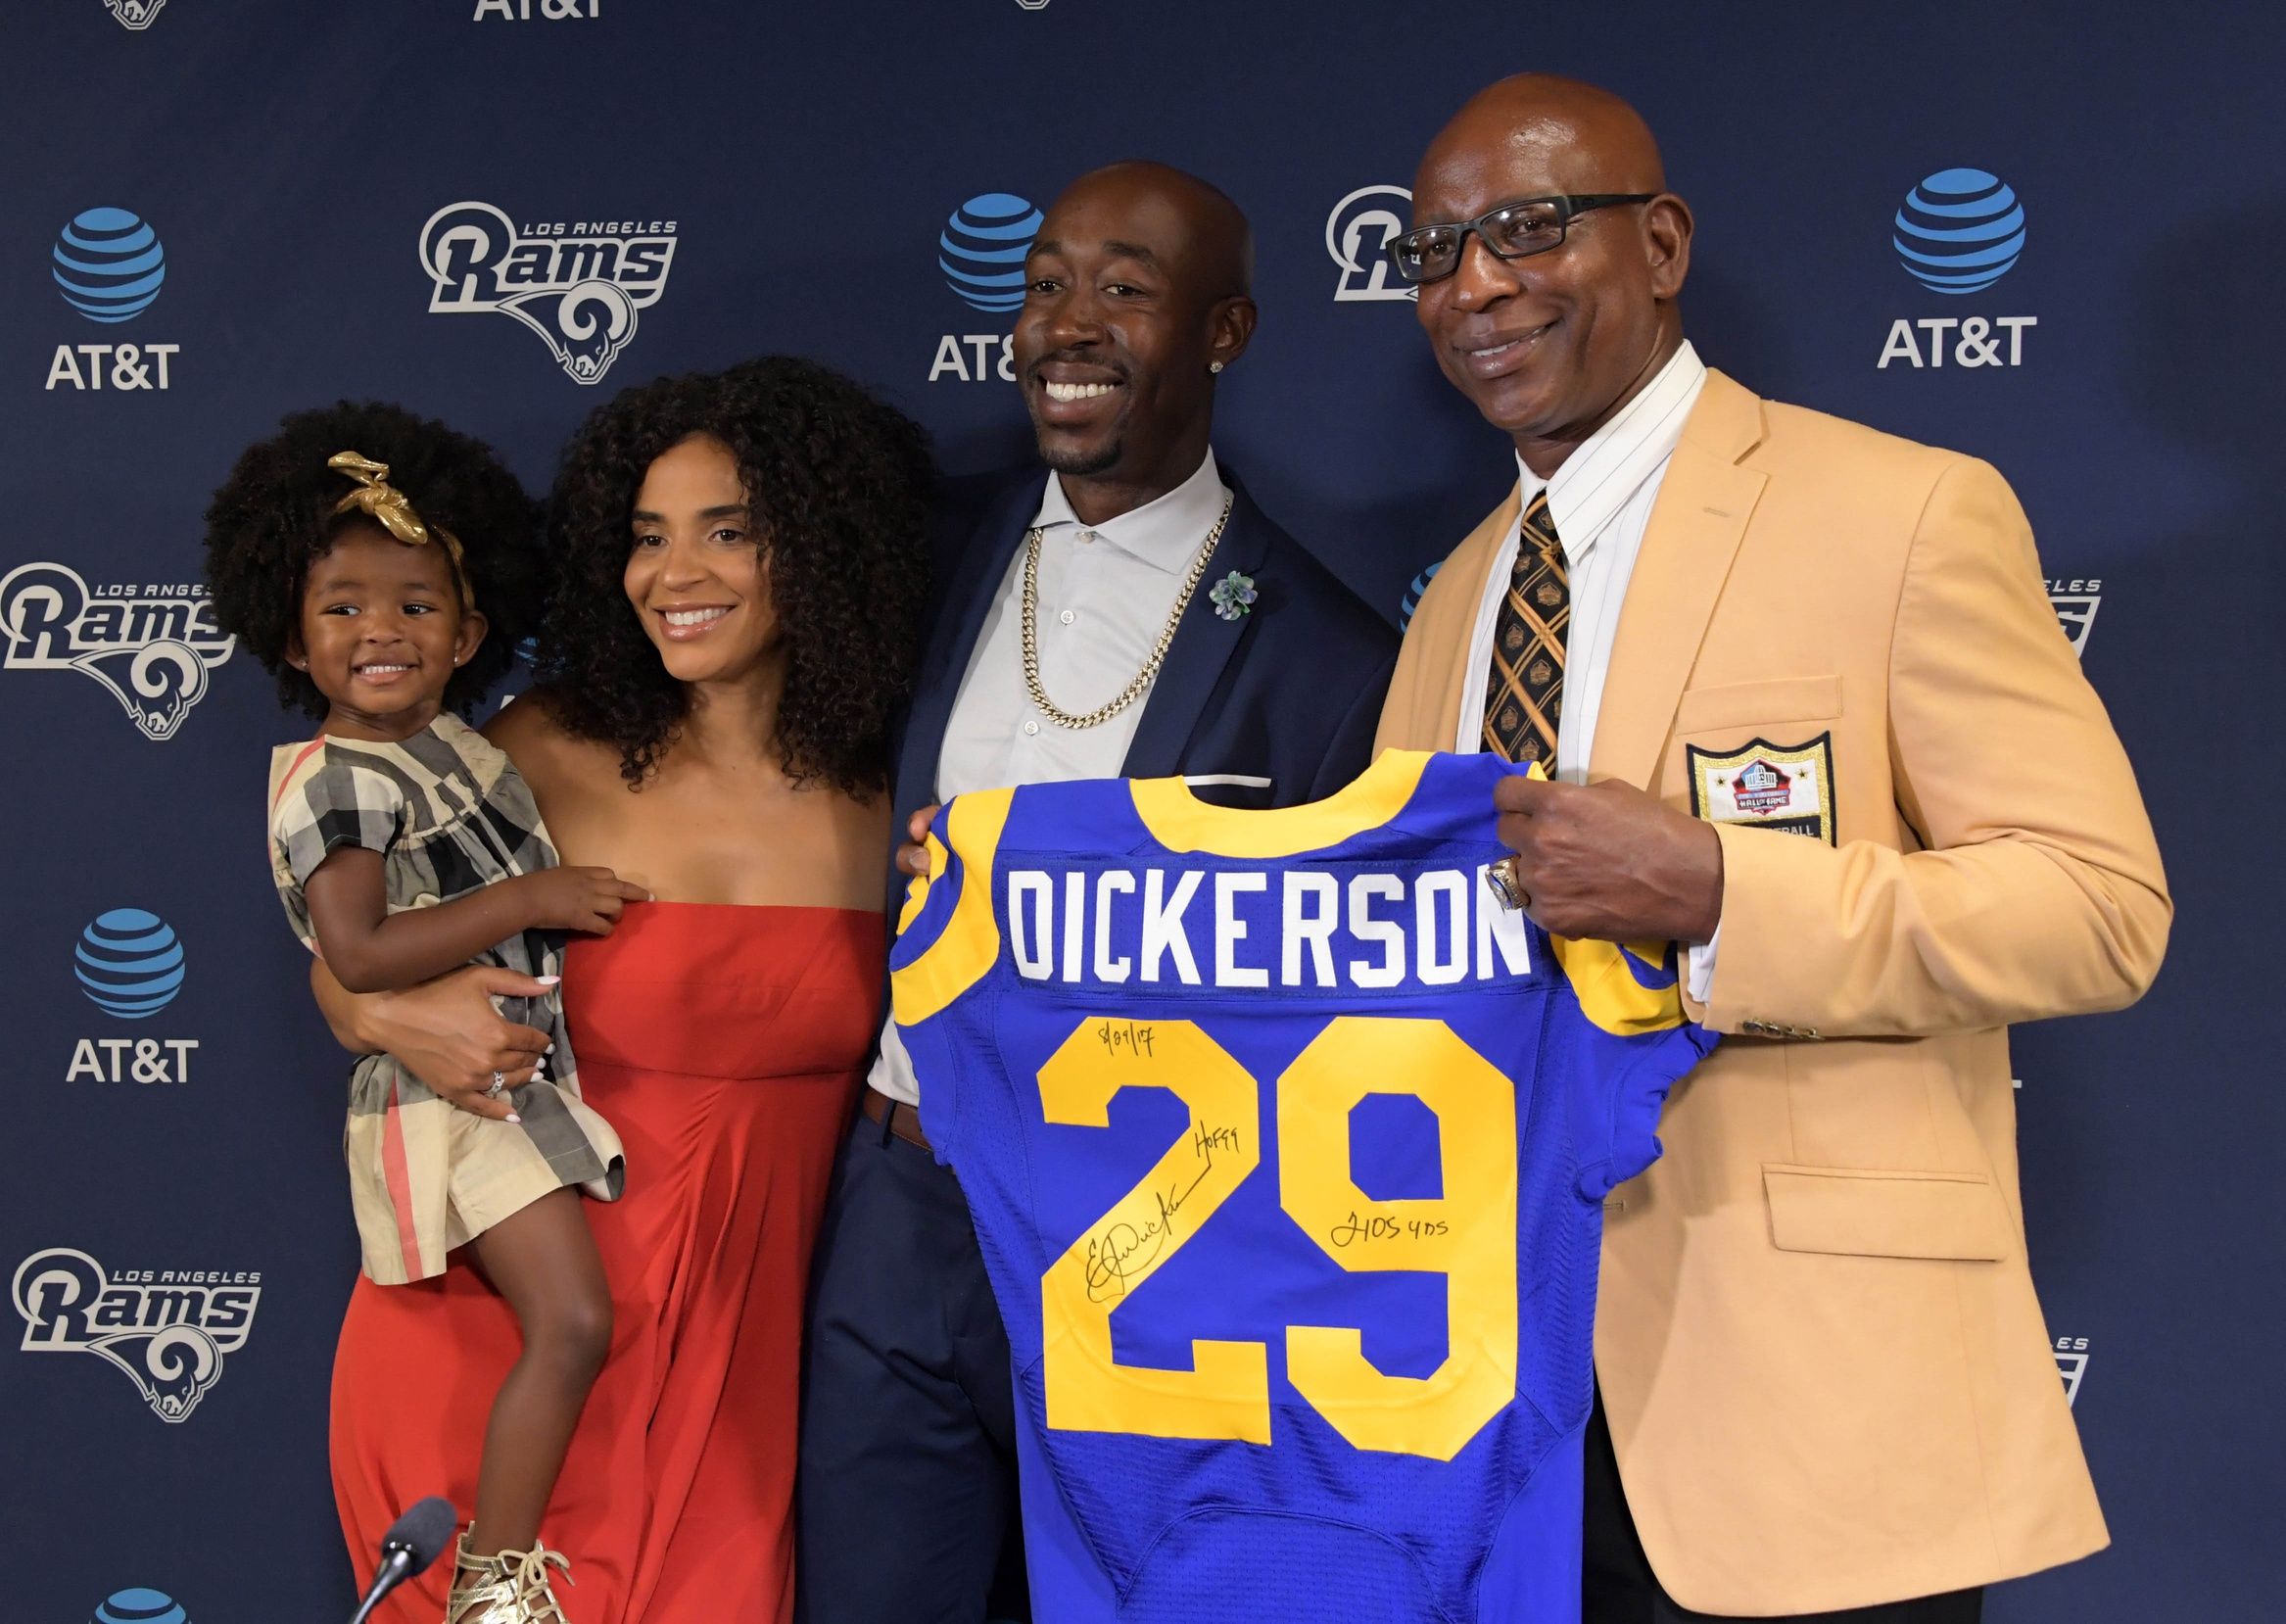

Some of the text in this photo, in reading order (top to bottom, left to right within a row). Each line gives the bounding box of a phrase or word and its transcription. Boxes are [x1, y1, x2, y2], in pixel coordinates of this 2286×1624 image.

[523, 221, 677, 234] LOS ANGELES
[929, 334, 1017, 381] AT&
[1878, 316, 2037, 368] AT&T
[46, 344, 180, 390] AT&T
[96, 585, 214, 596] LOS ANGE
[1009, 864, 1531, 988] DICKERSON
[67, 1038, 199, 1083] AT&T
[1035, 1016, 1518, 1461] 29
[113, 1270, 262, 1283] LOS ANGELES
